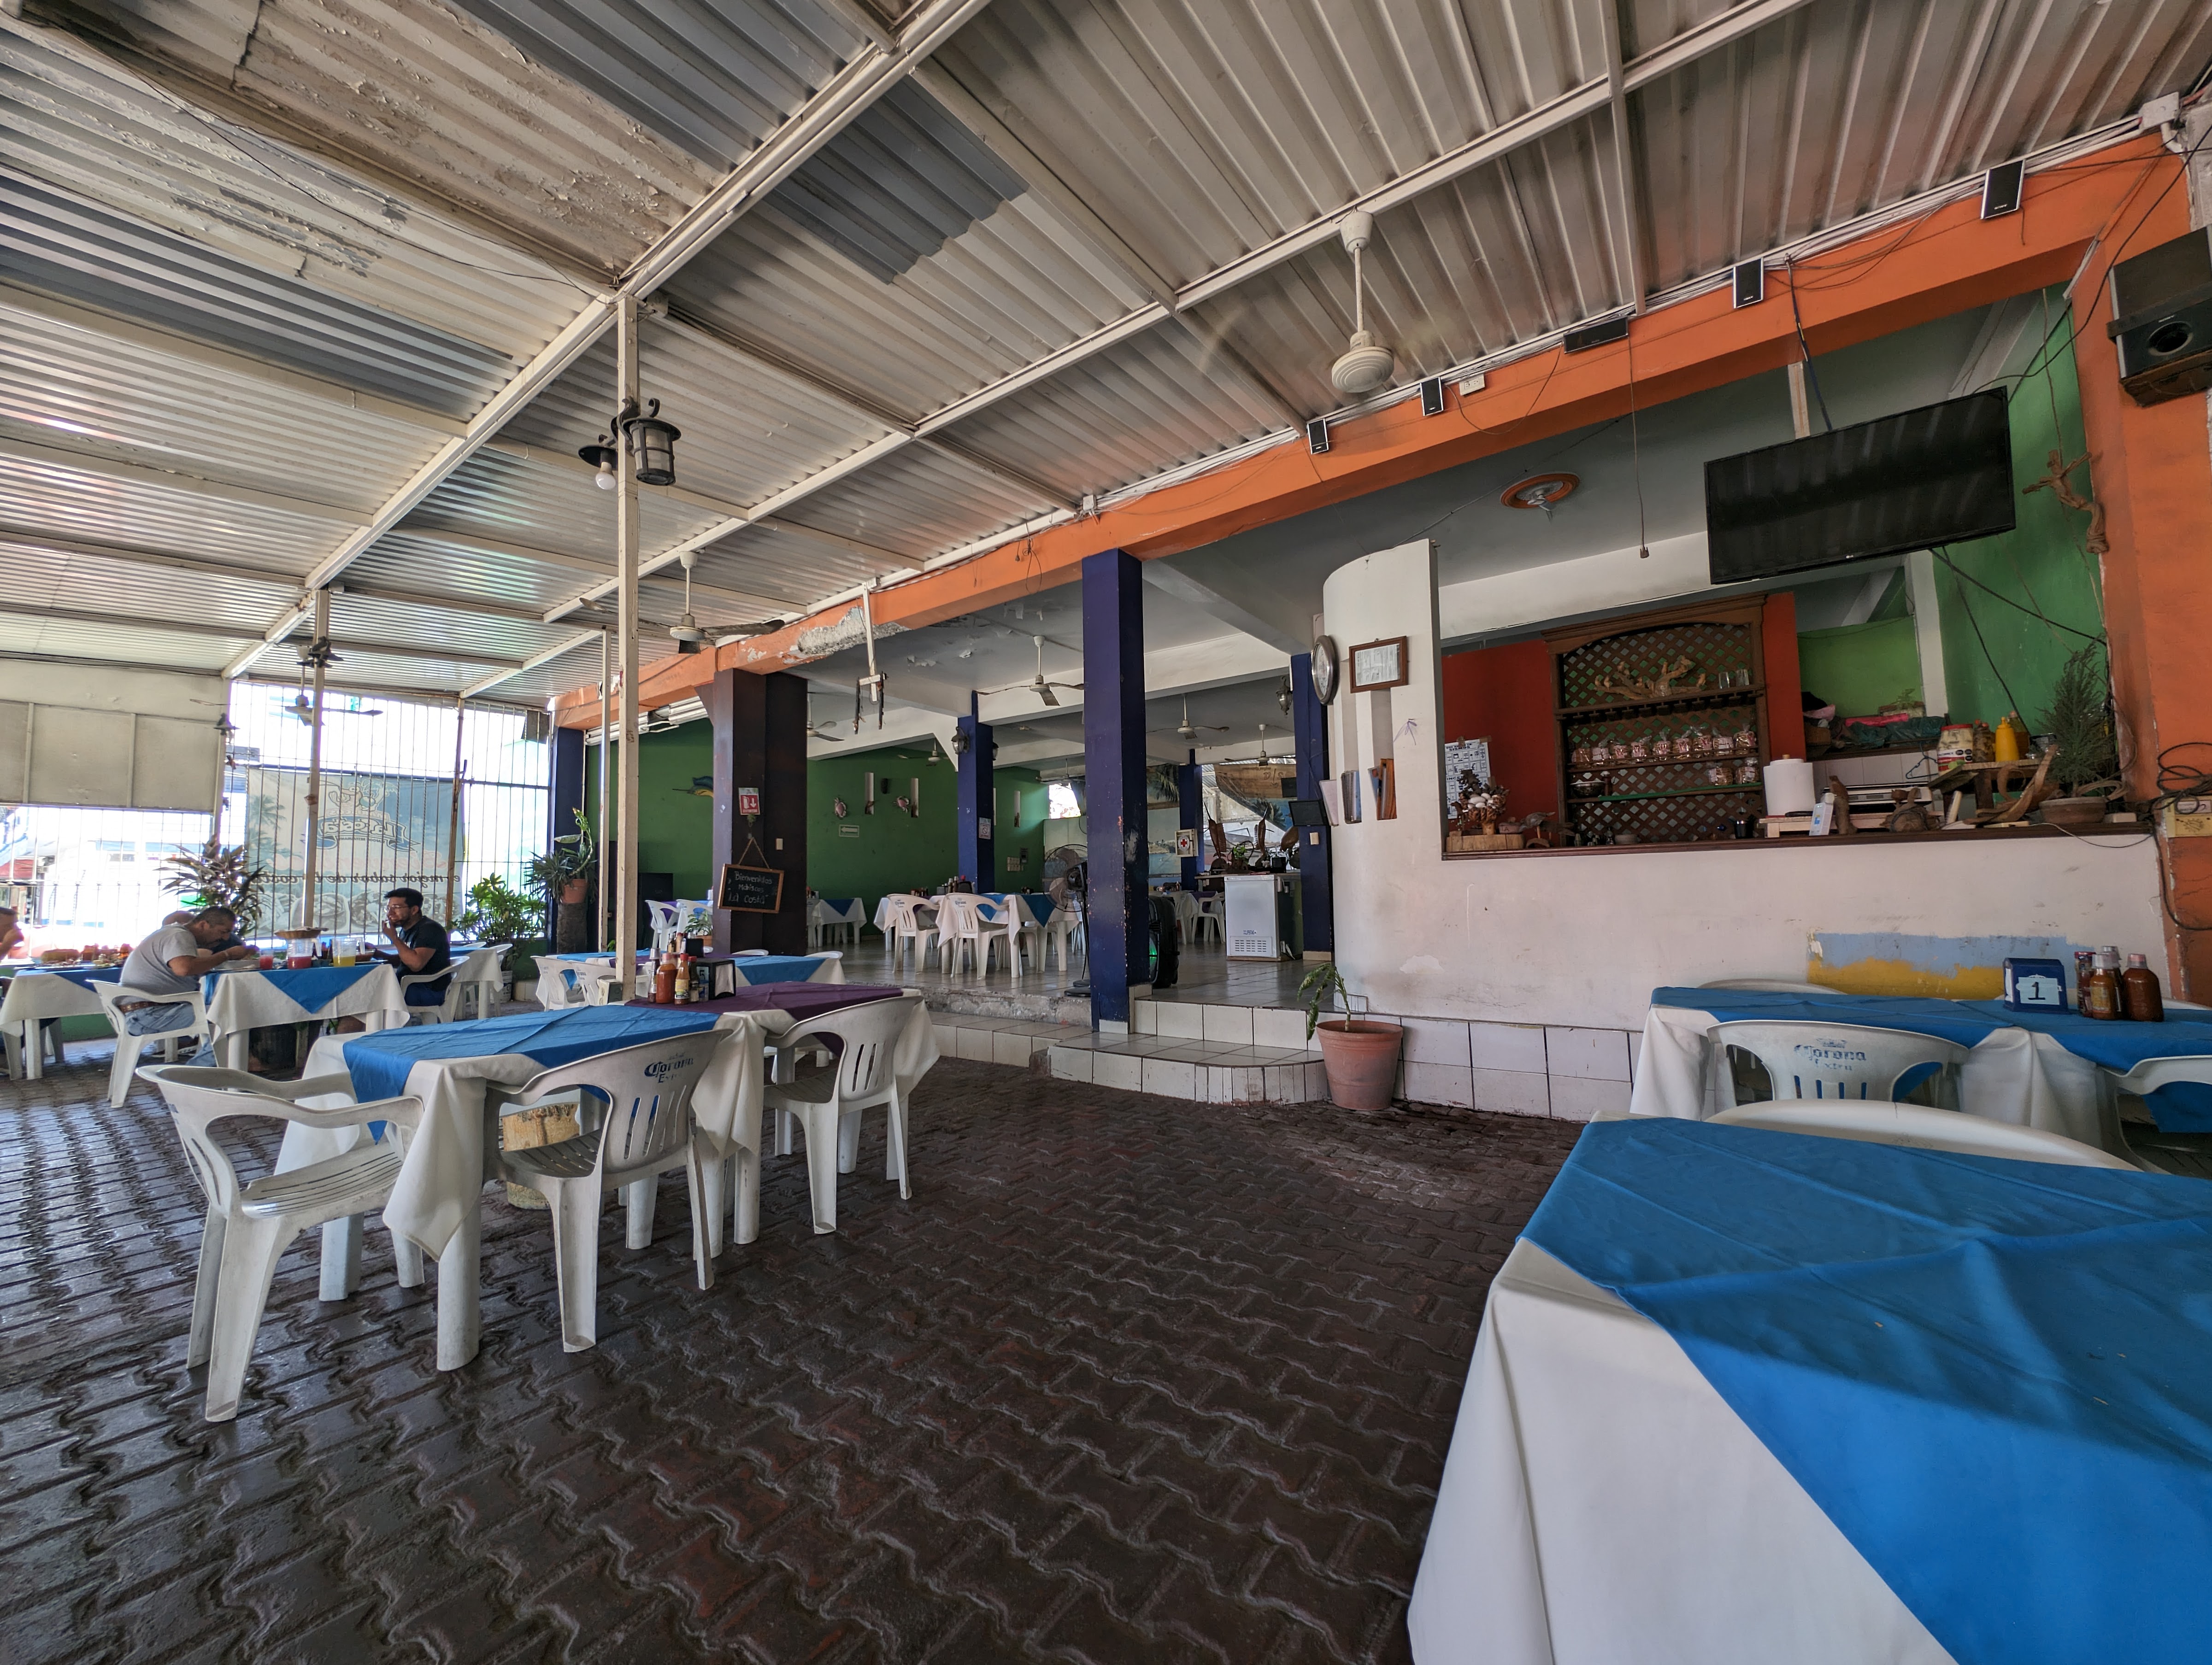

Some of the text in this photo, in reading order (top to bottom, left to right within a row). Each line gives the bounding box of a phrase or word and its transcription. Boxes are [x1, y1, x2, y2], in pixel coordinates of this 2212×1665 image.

[734, 870, 773, 885] Bienvenidos
[700, 970, 706, 980] 5
[2028, 981, 2046, 1000] 1
